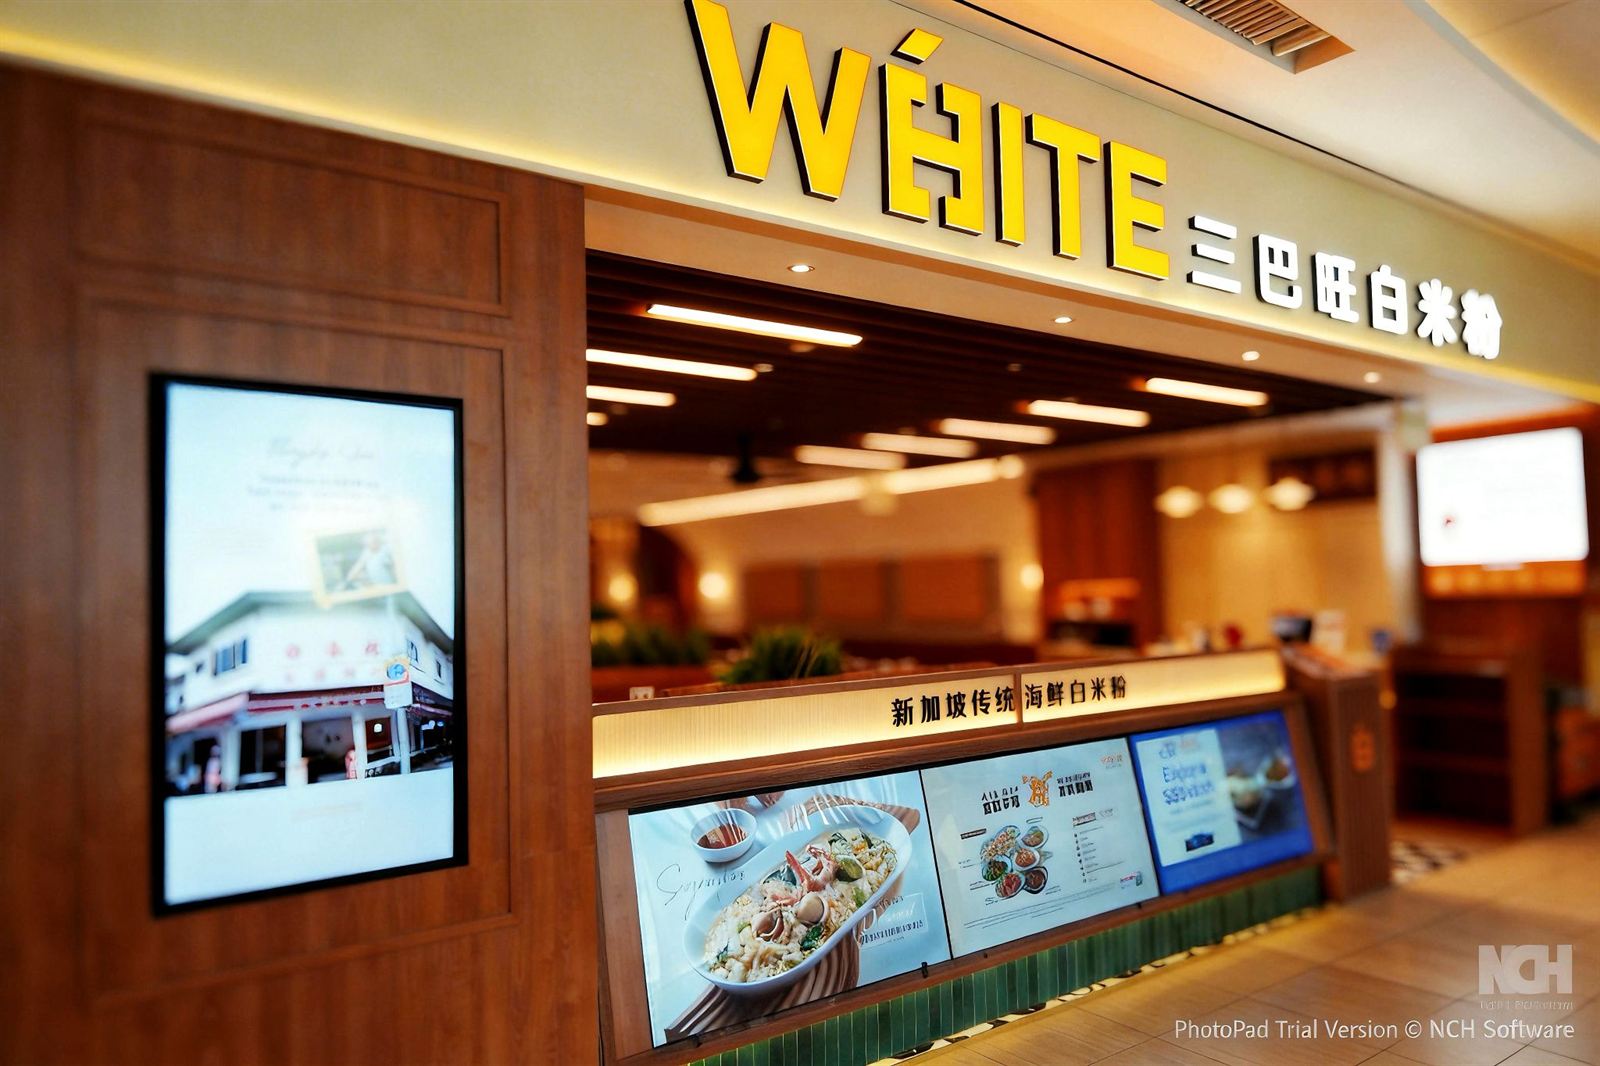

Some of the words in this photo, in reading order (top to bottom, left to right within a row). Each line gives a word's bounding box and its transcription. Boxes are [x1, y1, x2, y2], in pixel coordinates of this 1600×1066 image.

[684, 0, 1170, 281] WHITE
[1187, 214, 1503, 361] 三巴旺白米粉
